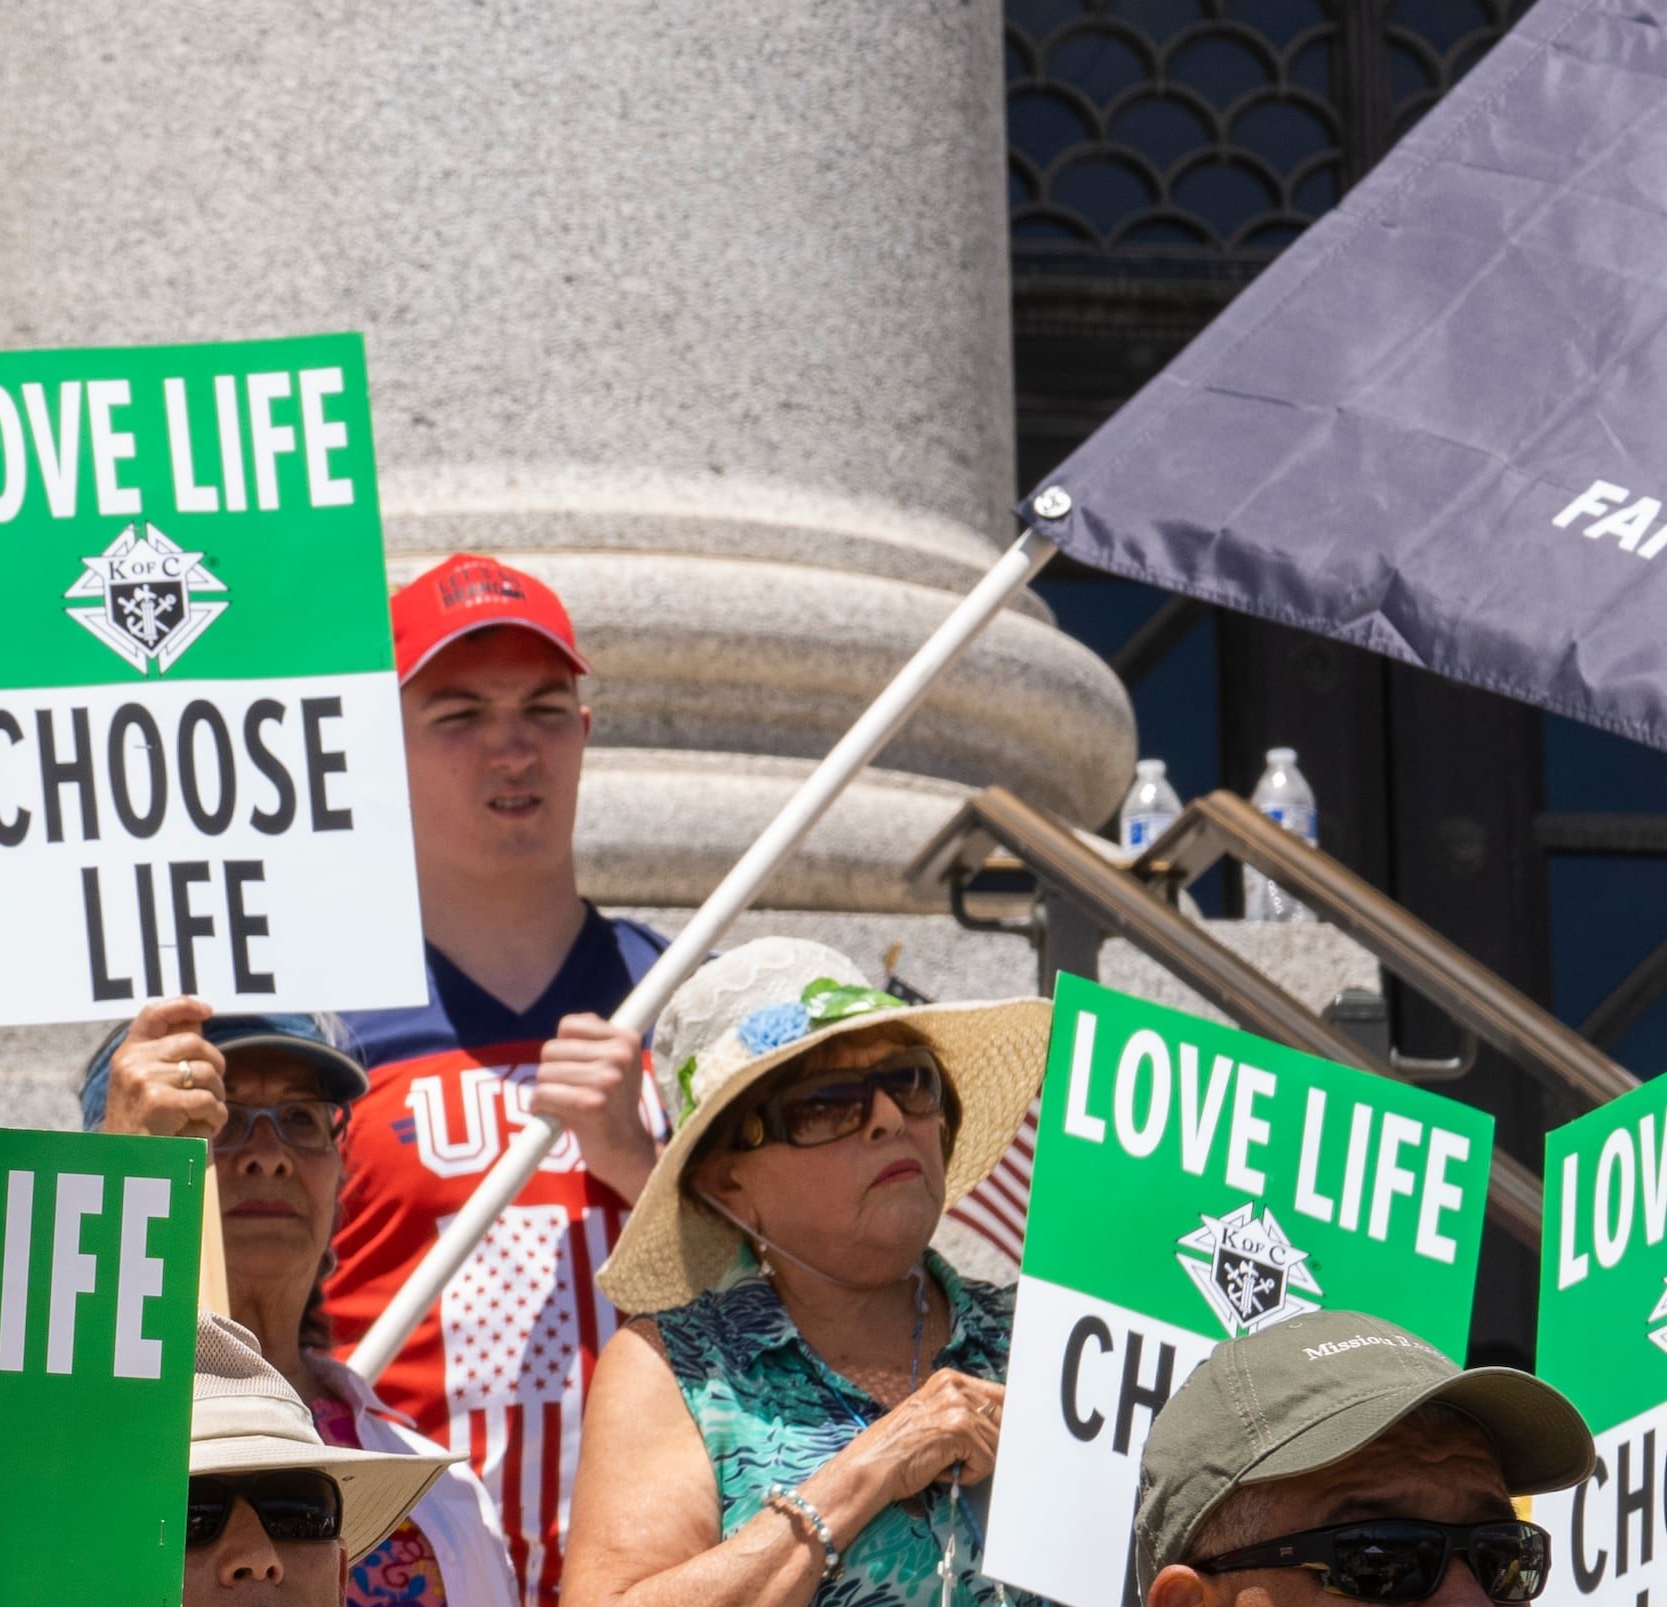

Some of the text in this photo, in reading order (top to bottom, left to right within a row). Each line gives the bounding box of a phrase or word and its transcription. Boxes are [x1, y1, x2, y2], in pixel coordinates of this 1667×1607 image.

[164, 367, 354, 513] LIFE
[108, 557, 181, 580] K OF C
[80, 860, 276, 1002] LIFE
[1064, 1011, 1470, 1264] LOVE LIFE
[1222, 1227, 1241, 1249] K
[1269, 1244, 1286, 1265] C
[1302, 1334, 1396, 1361] Mission
